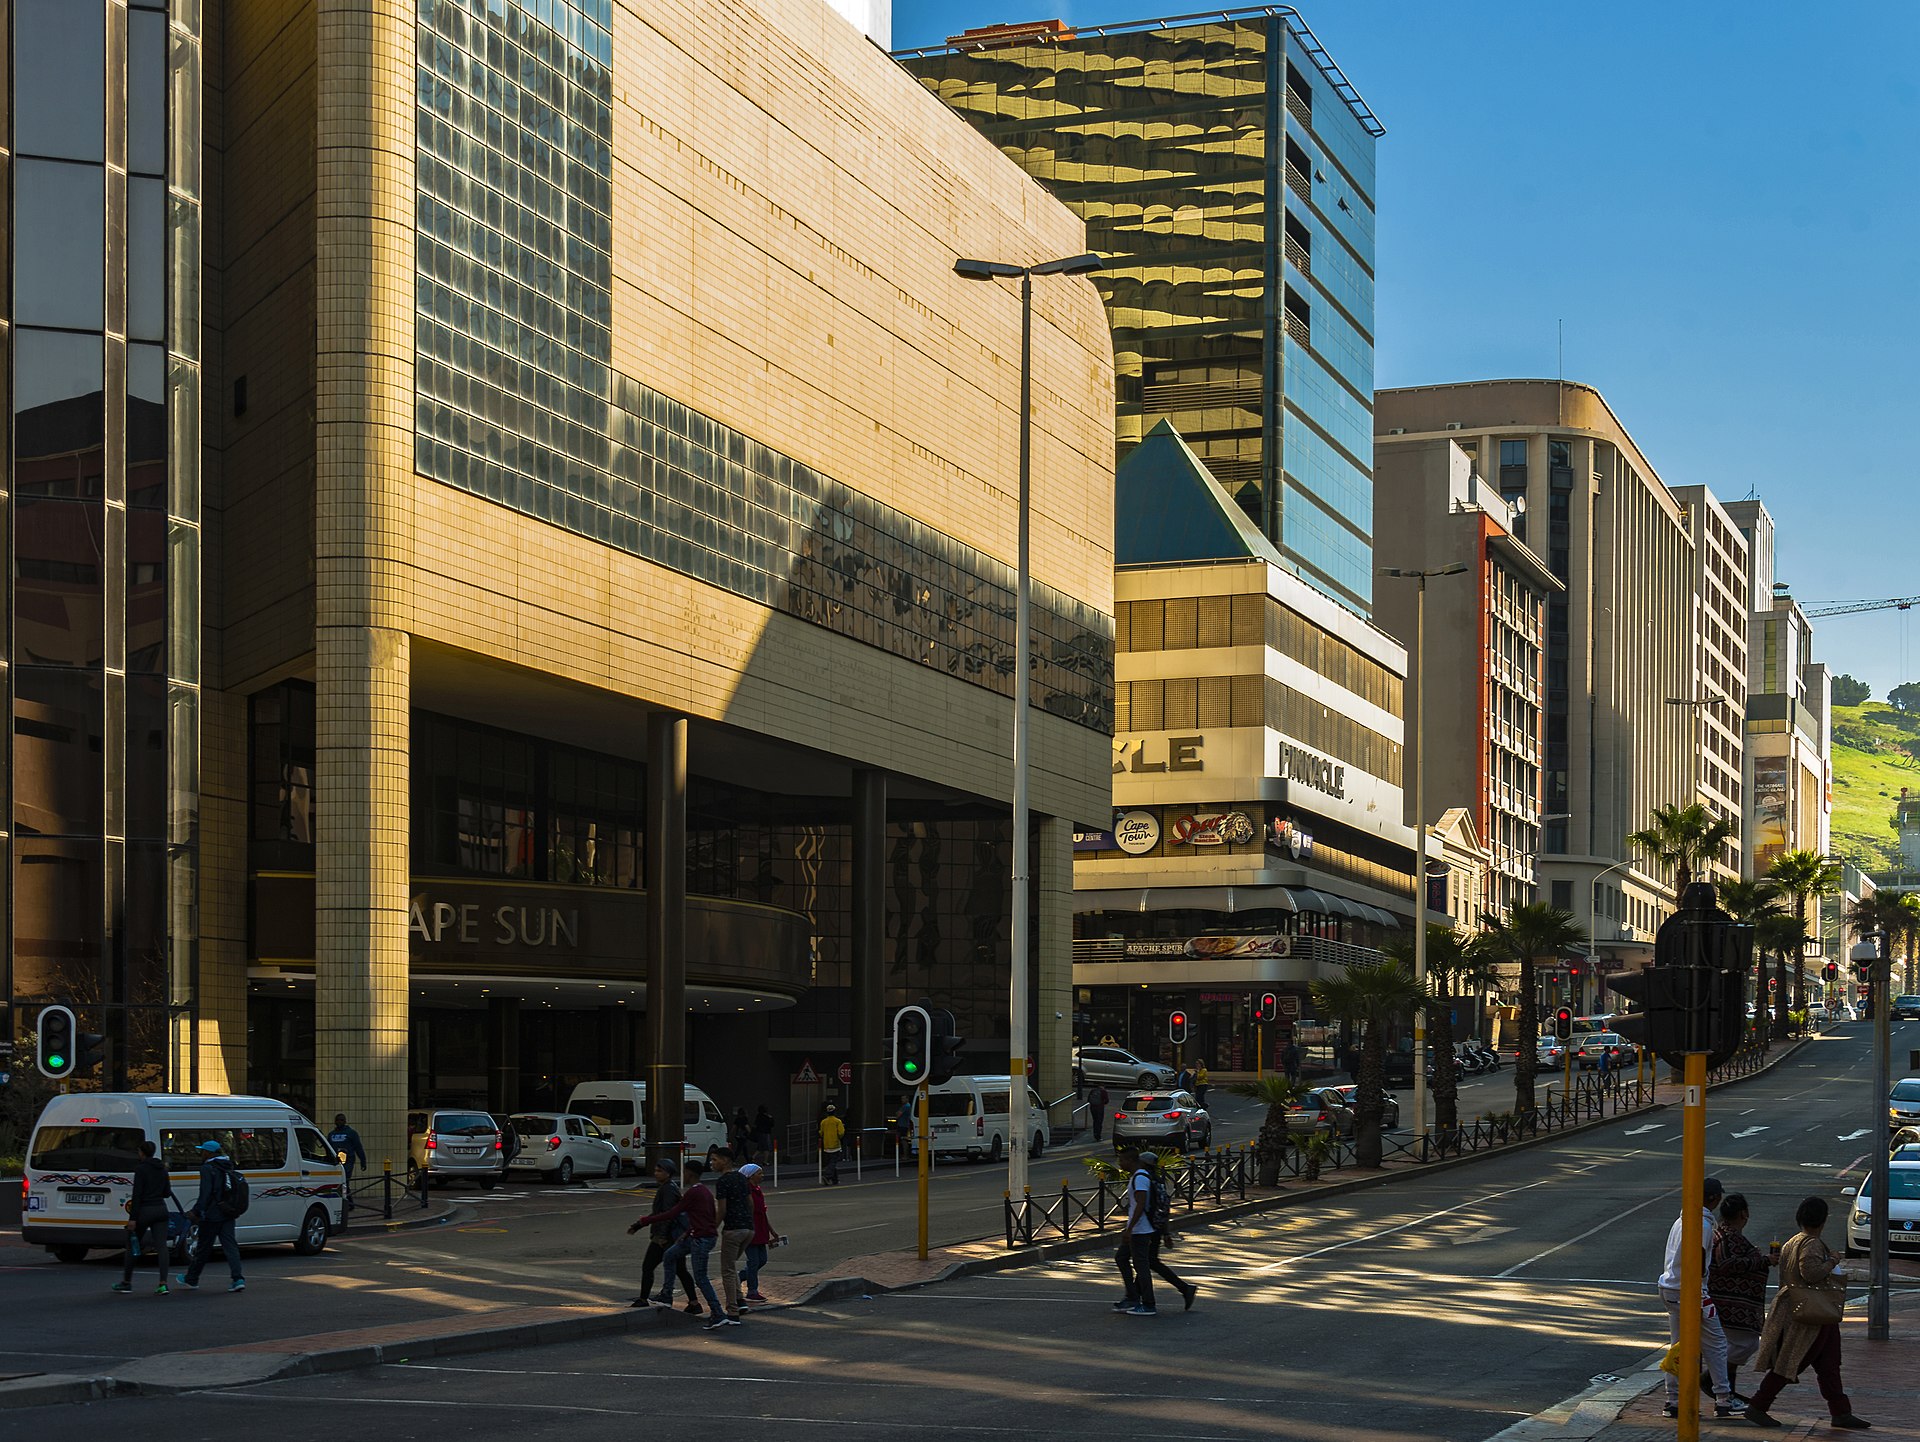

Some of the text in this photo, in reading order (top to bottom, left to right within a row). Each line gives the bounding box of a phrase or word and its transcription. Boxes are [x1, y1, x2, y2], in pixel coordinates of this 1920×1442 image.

[1279, 741, 1344, 800] PINNACLE
[1119, 830, 1155, 844] Town
[1124, 818, 1149, 833] Cape
[1167, 814, 1227, 845] Spur
[409, 902, 578, 946] APE SUN
[1688, 1088, 1695, 1104] 1
